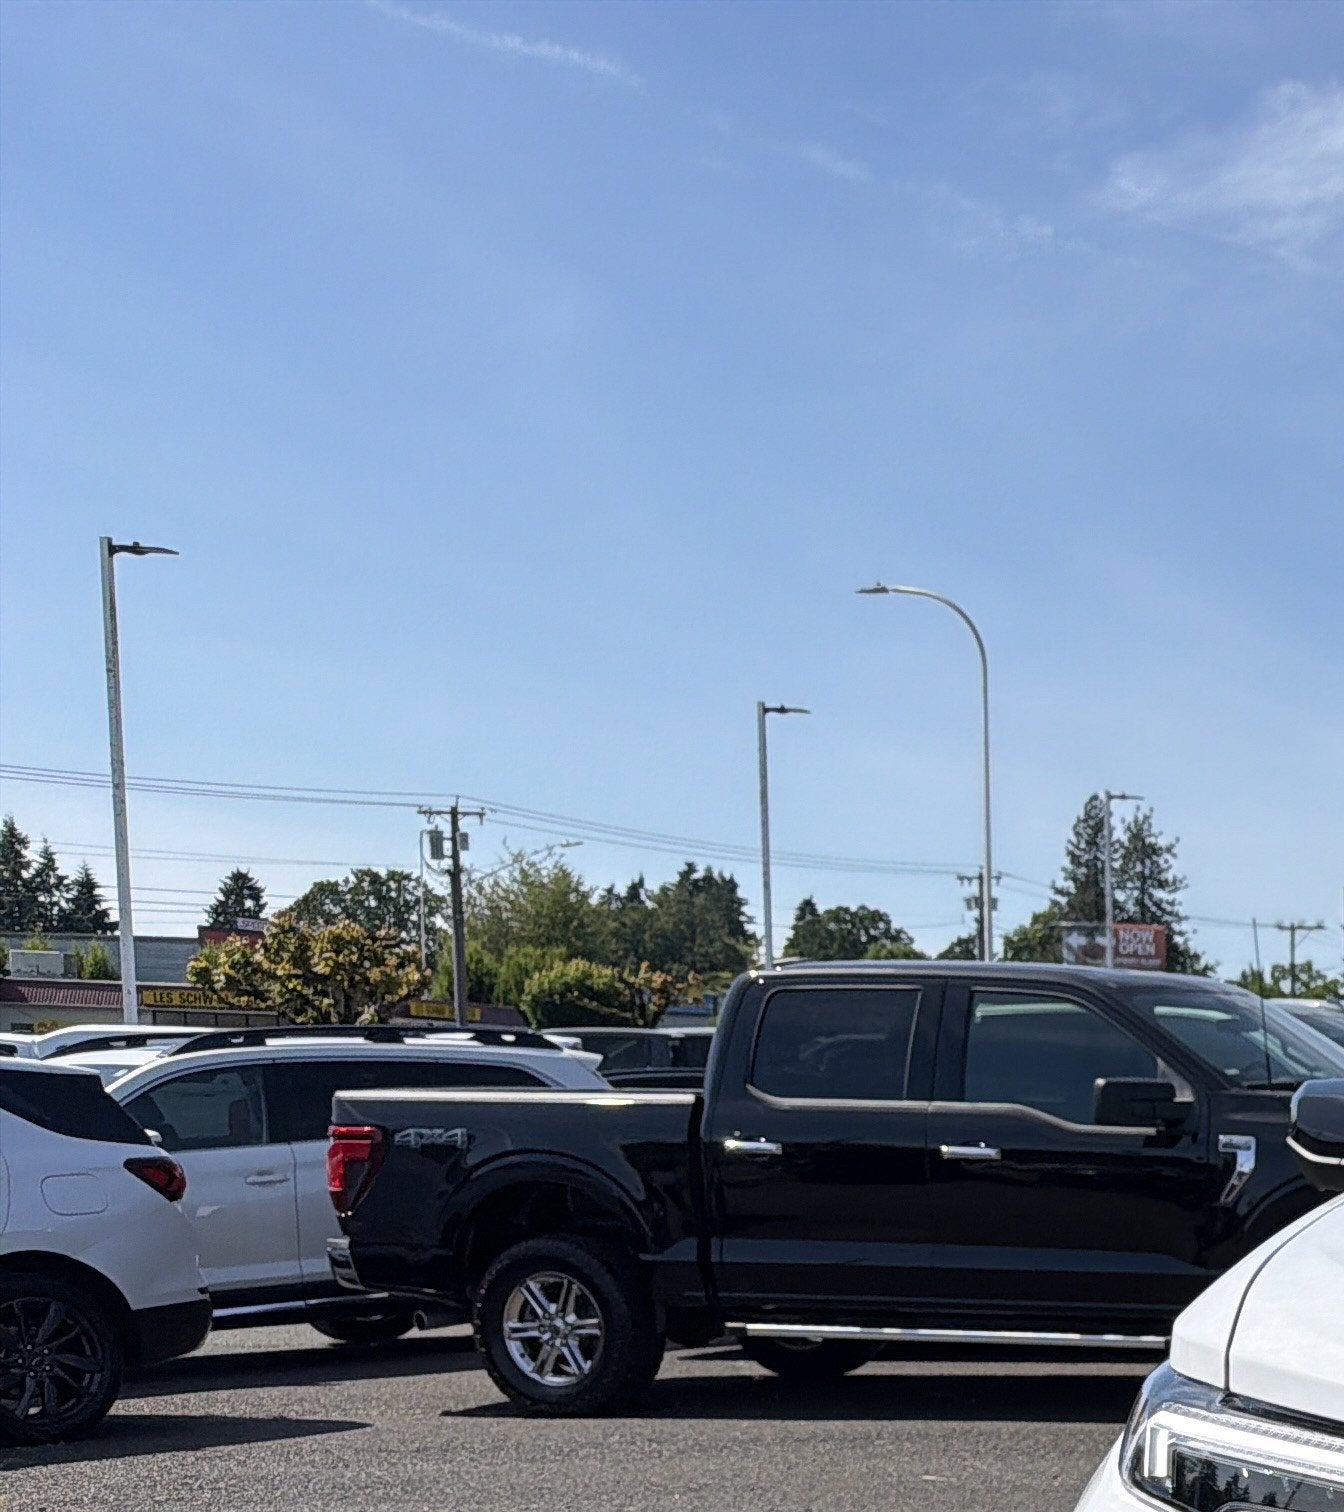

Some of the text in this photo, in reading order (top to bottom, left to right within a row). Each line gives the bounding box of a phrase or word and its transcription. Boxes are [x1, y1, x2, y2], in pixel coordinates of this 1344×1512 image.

[1119, 929, 1155, 944] NOW
[1119, 943, 1156, 956] OPEN
[153, 991, 174, 1004] LES
